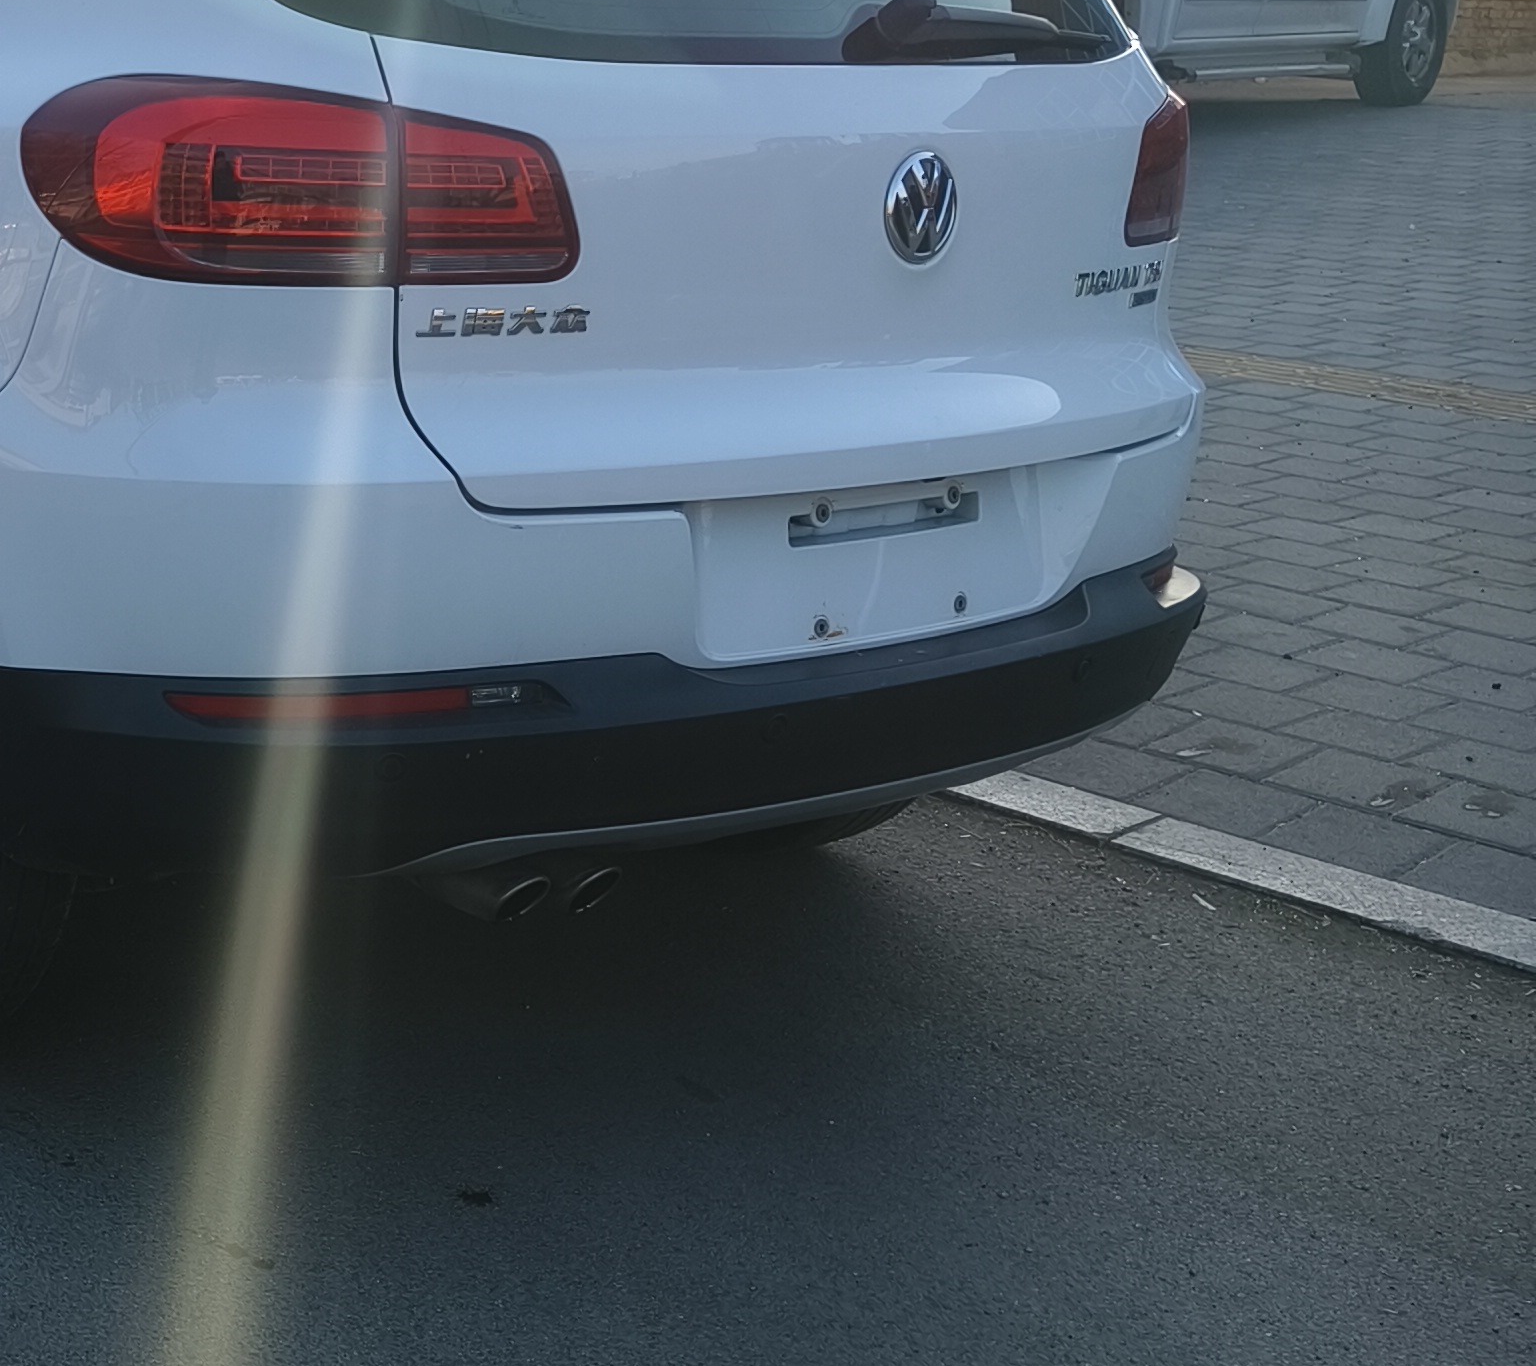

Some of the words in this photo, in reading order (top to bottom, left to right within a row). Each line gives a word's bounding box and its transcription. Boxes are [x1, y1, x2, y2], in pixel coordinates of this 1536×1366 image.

[1073, 265, 1142, 298] TIGUAN
[415, 304, 591, 338] 上海大众
